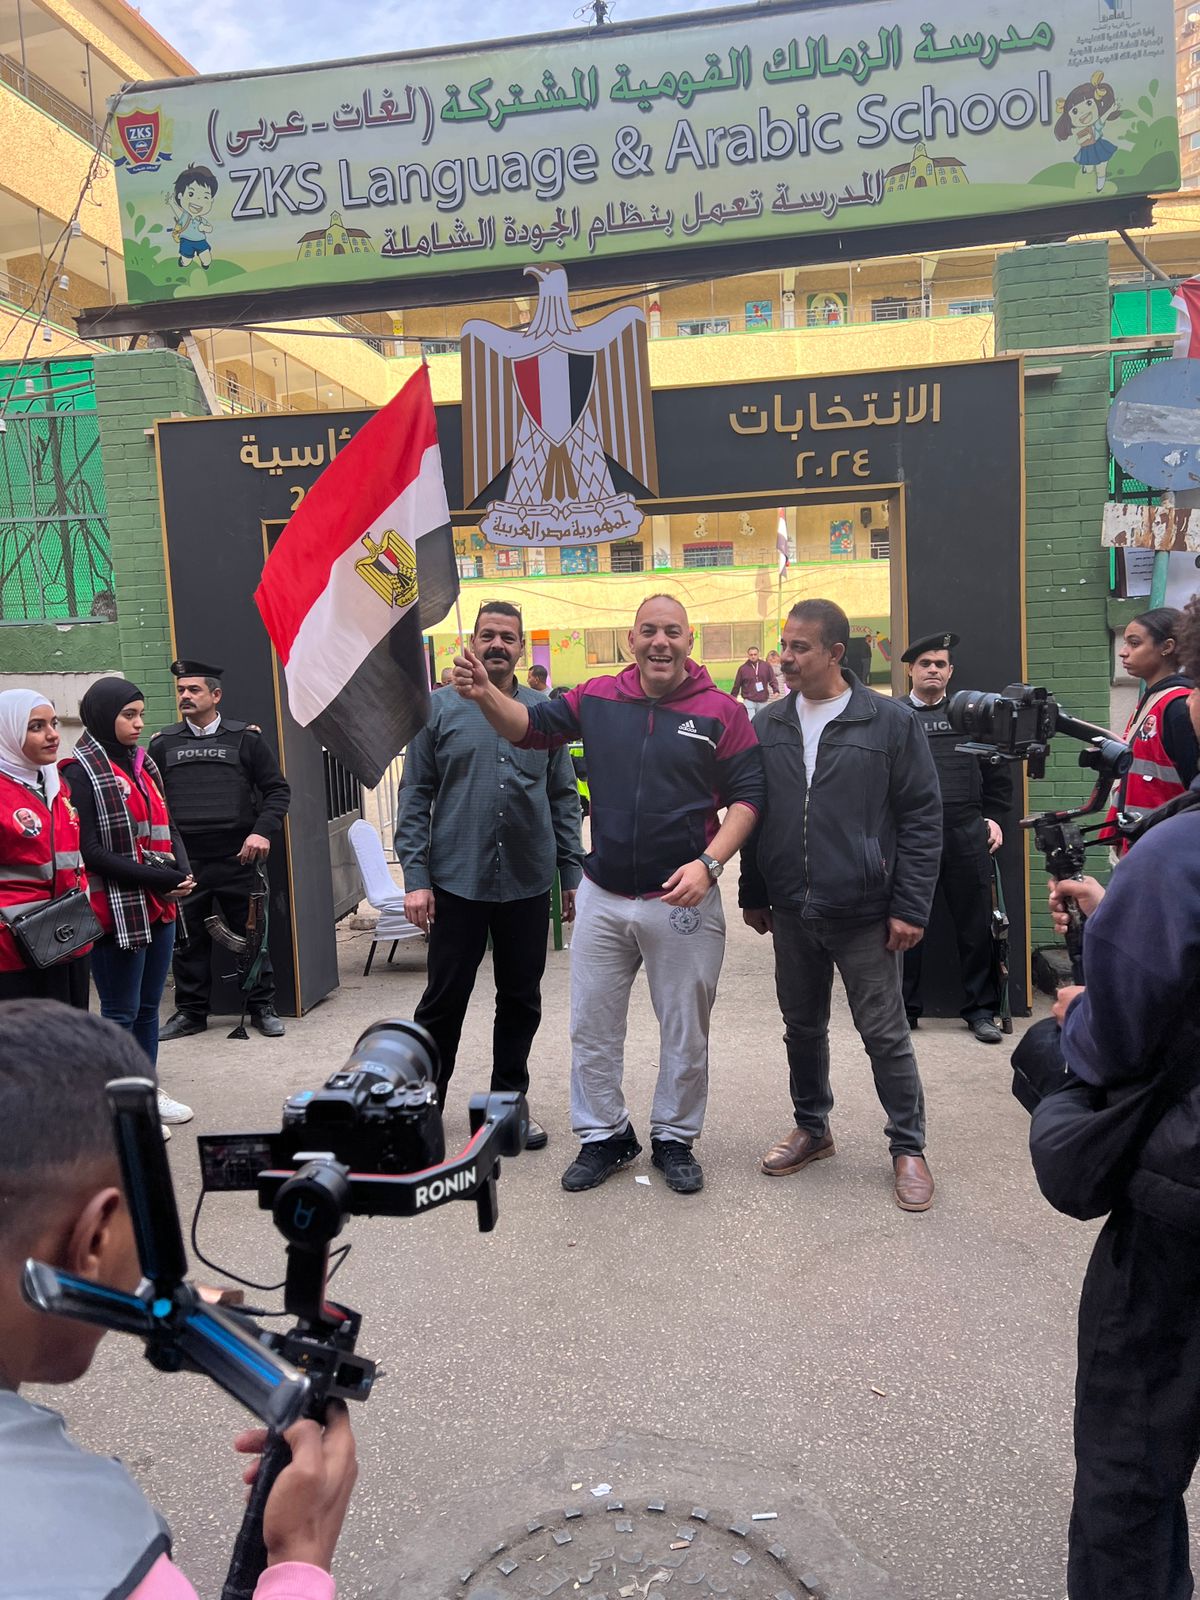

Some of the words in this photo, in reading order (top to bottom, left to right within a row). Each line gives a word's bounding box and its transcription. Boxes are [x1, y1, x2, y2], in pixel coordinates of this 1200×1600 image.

[762, 24, 902, 84] الزمالك
[913, 21, 1055, 67] مدرسة
[440, 65, 600, 130] المشتركة
[609, 46, 750, 112] القومية
[129, 127, 152, 140] ZKS
[228, 161, 326, 220] ZKS
[338, 141, 599, 213] Language
[611, 125, 653, 178] &
[664, 104, 843, 172] Arabic
[856, 70, 1052, 148] School
[680, 188, 763, 235] تعمل
[770, 168, 886, 218] المدرسة
[380, 216, 496, 258] الشاملة
[502, 206, 580, 253] الجودة
[587, 200, 675, 253] بنظام
[728, 383, 942, 442] الانتخابات
[796, 449, 871, 480] ٢٠٢٤
[492, 515, 540, 541] العربية
[538, 526, 571, 542] مصر
[571, 509, 632, 540] جمهورية
[924, 720, 953, 732] LIC
[176, 748, 227, 761] POLICE
[415, 1166, 476, 1207] RONIN
